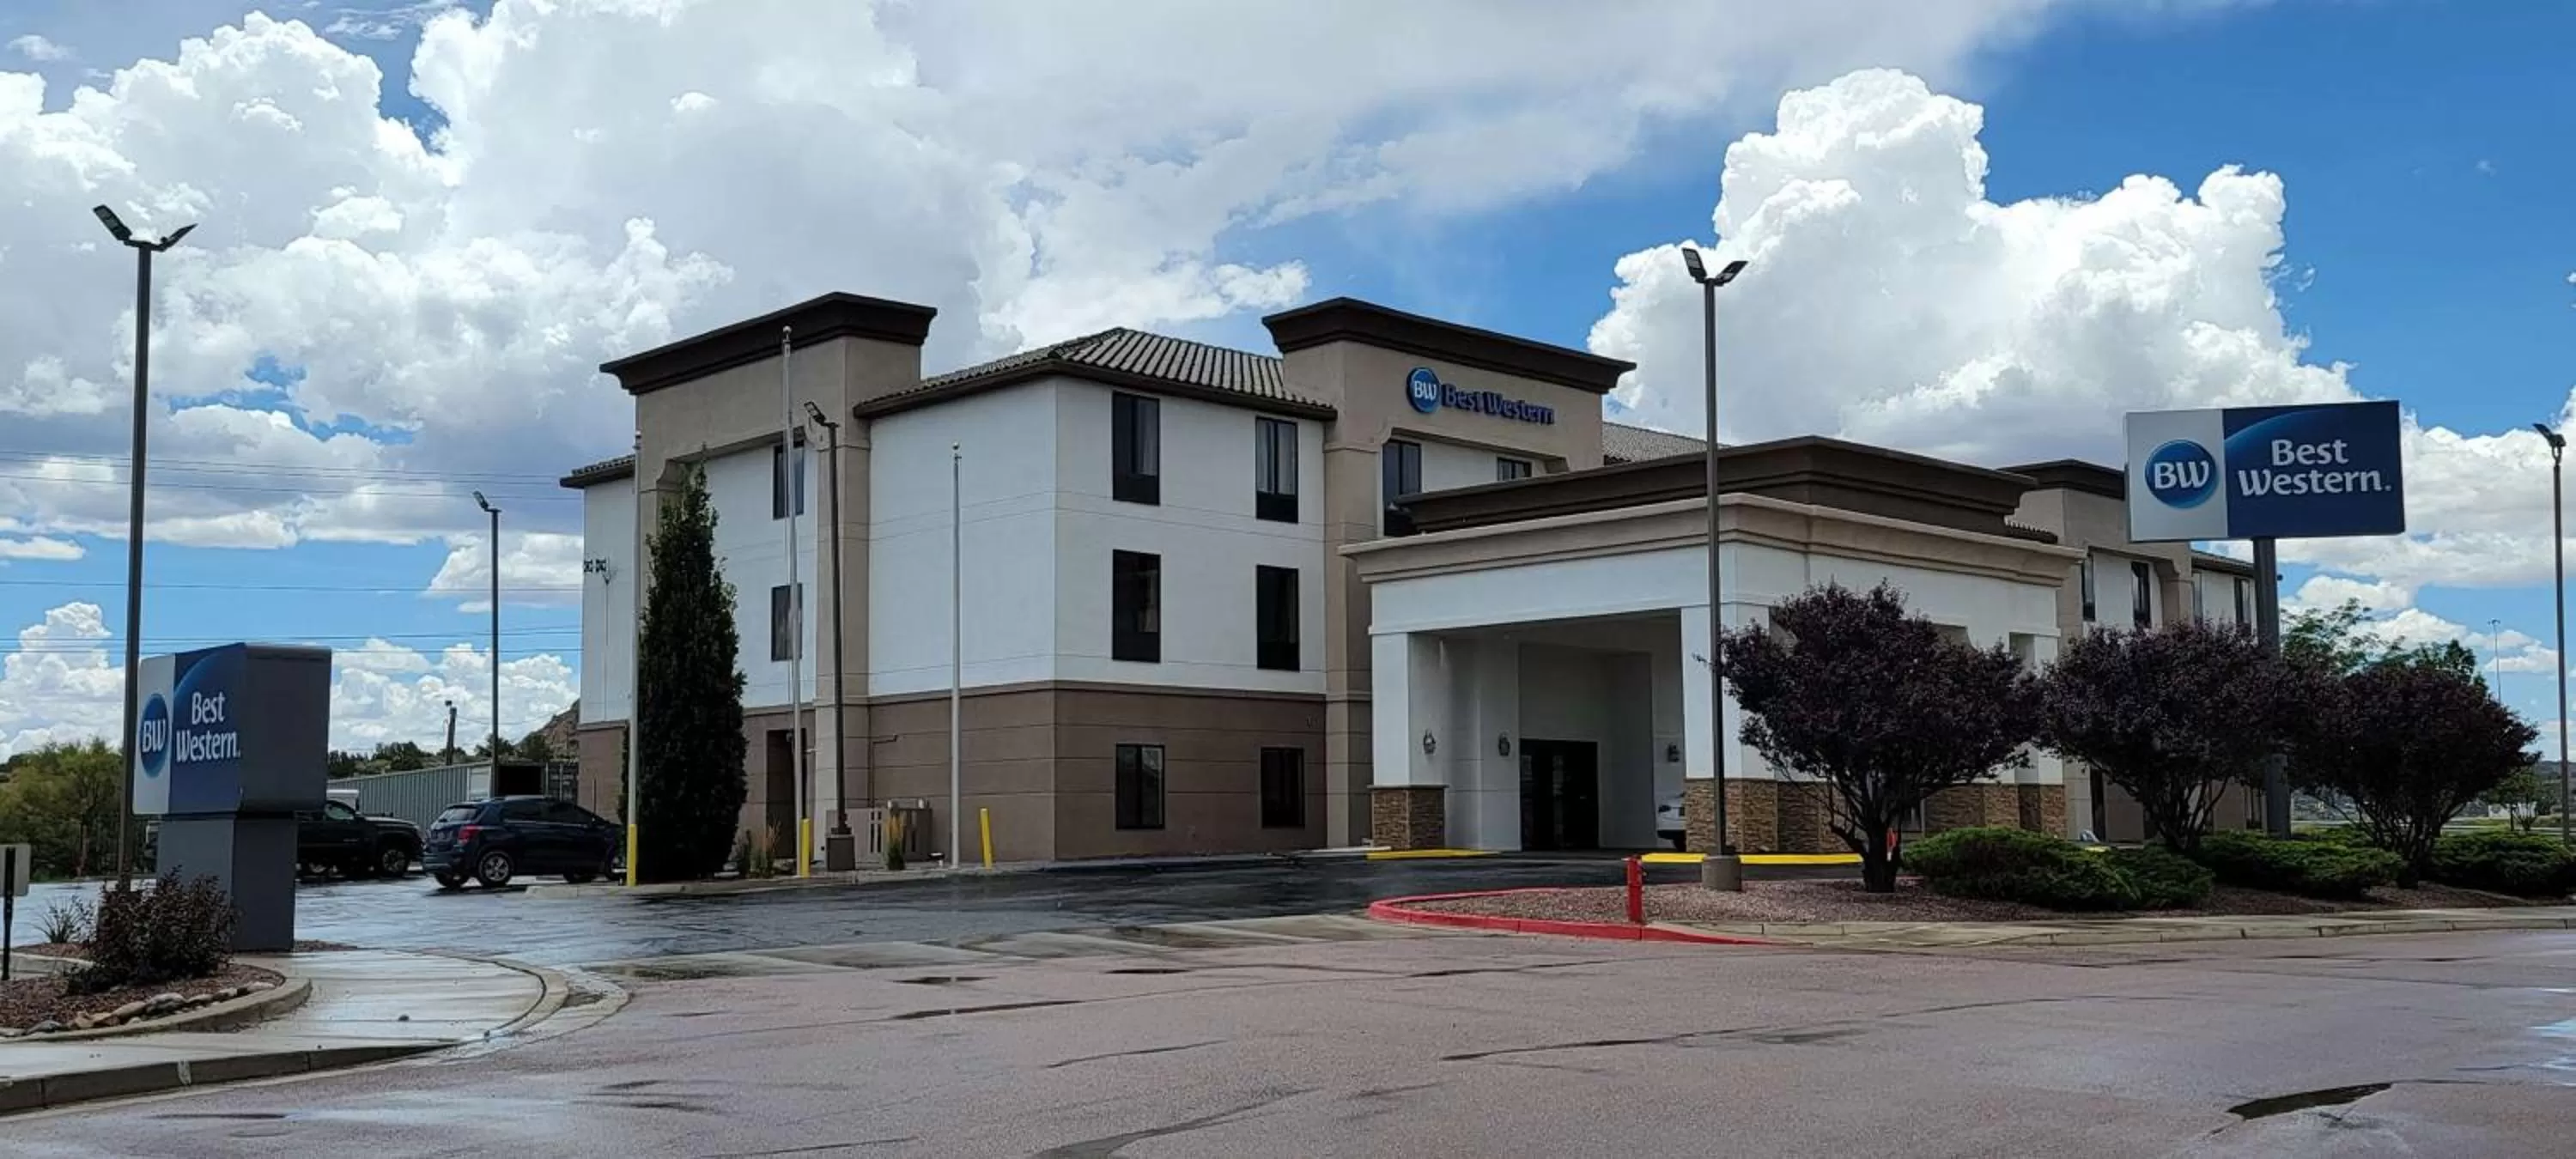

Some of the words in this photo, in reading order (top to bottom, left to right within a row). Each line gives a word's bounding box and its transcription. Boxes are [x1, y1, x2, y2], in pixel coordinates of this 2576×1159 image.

[1414, 380, 1437, 401] BW
[1442, 384, 1484, 413] Best
[1483, 391, 1555, 425] Western
[2271, 439, 2349, 467] Best
[2154, 459, 2209, 490] BW
[191, 691, 225, 725] Best
[142, 719, 167, 753] BW
